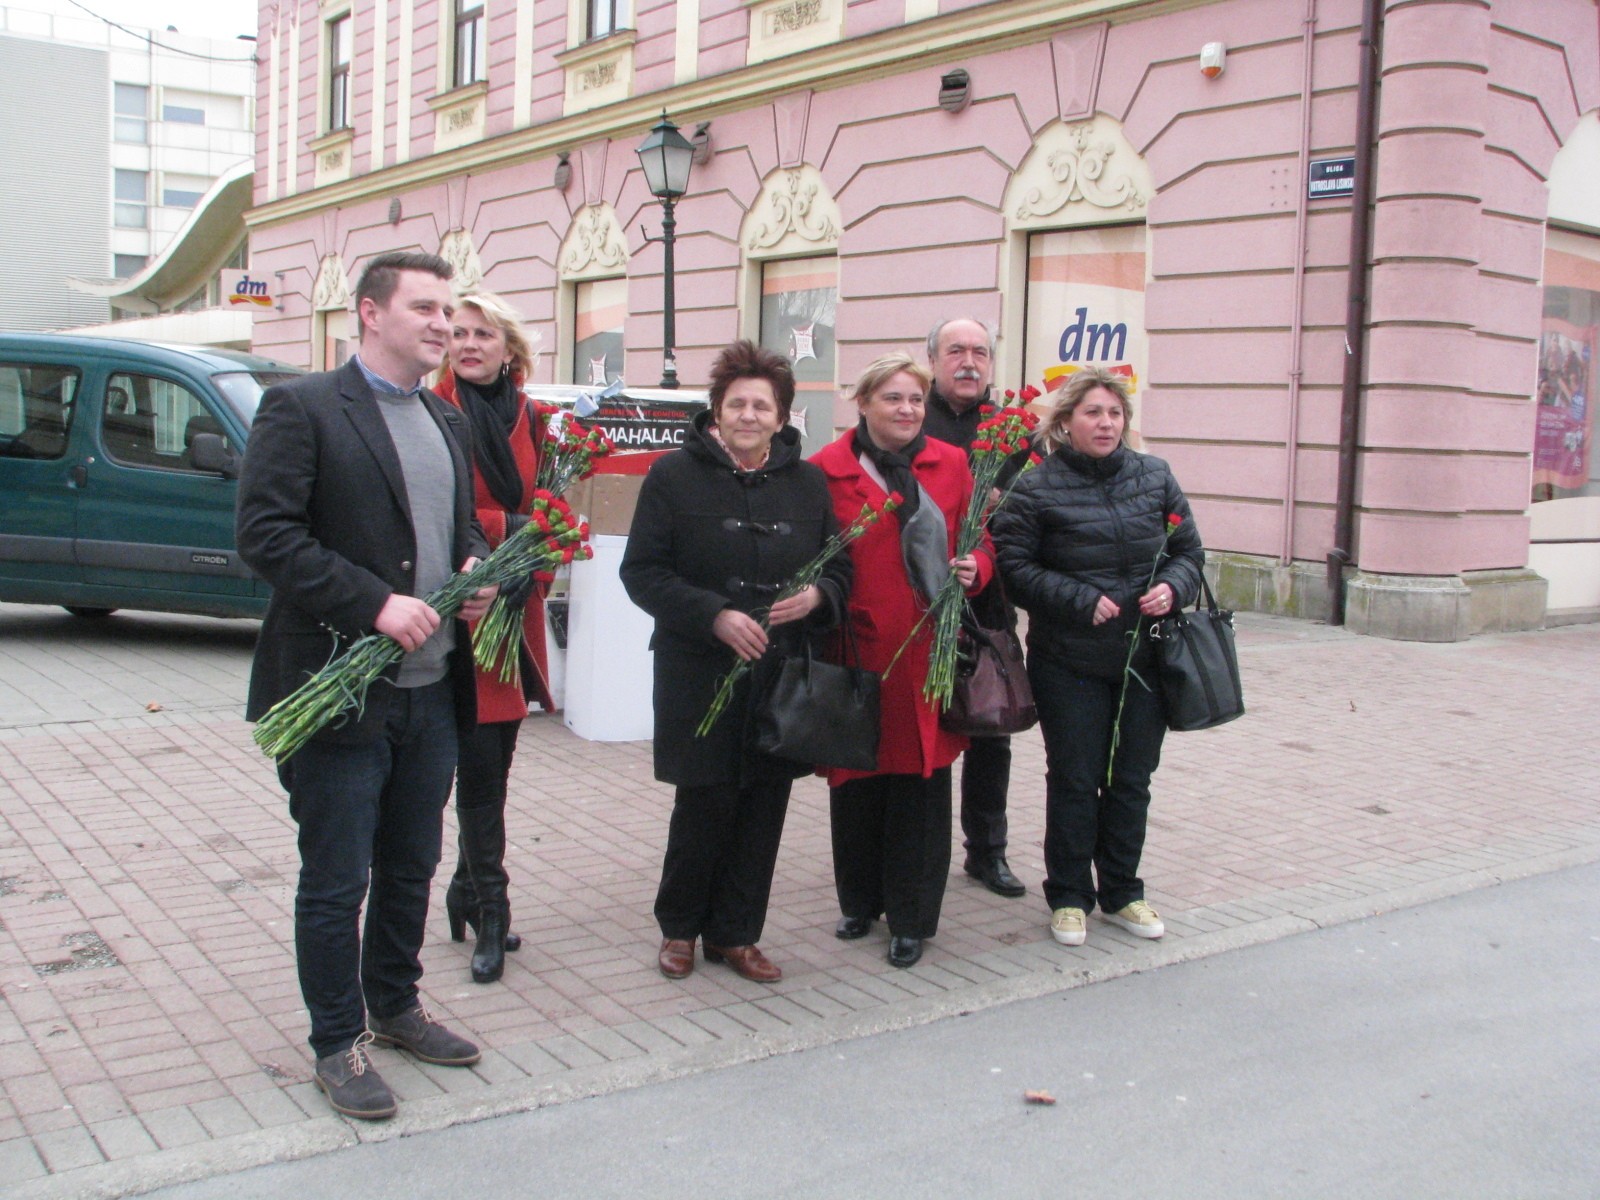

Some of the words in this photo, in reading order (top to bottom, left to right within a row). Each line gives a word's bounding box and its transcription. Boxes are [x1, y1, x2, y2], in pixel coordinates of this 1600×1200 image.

[1337, 177, 1354, 189] LISINSK
[236, 275, 267, 295] dm
[1058, 307, 1127, 362] dm
